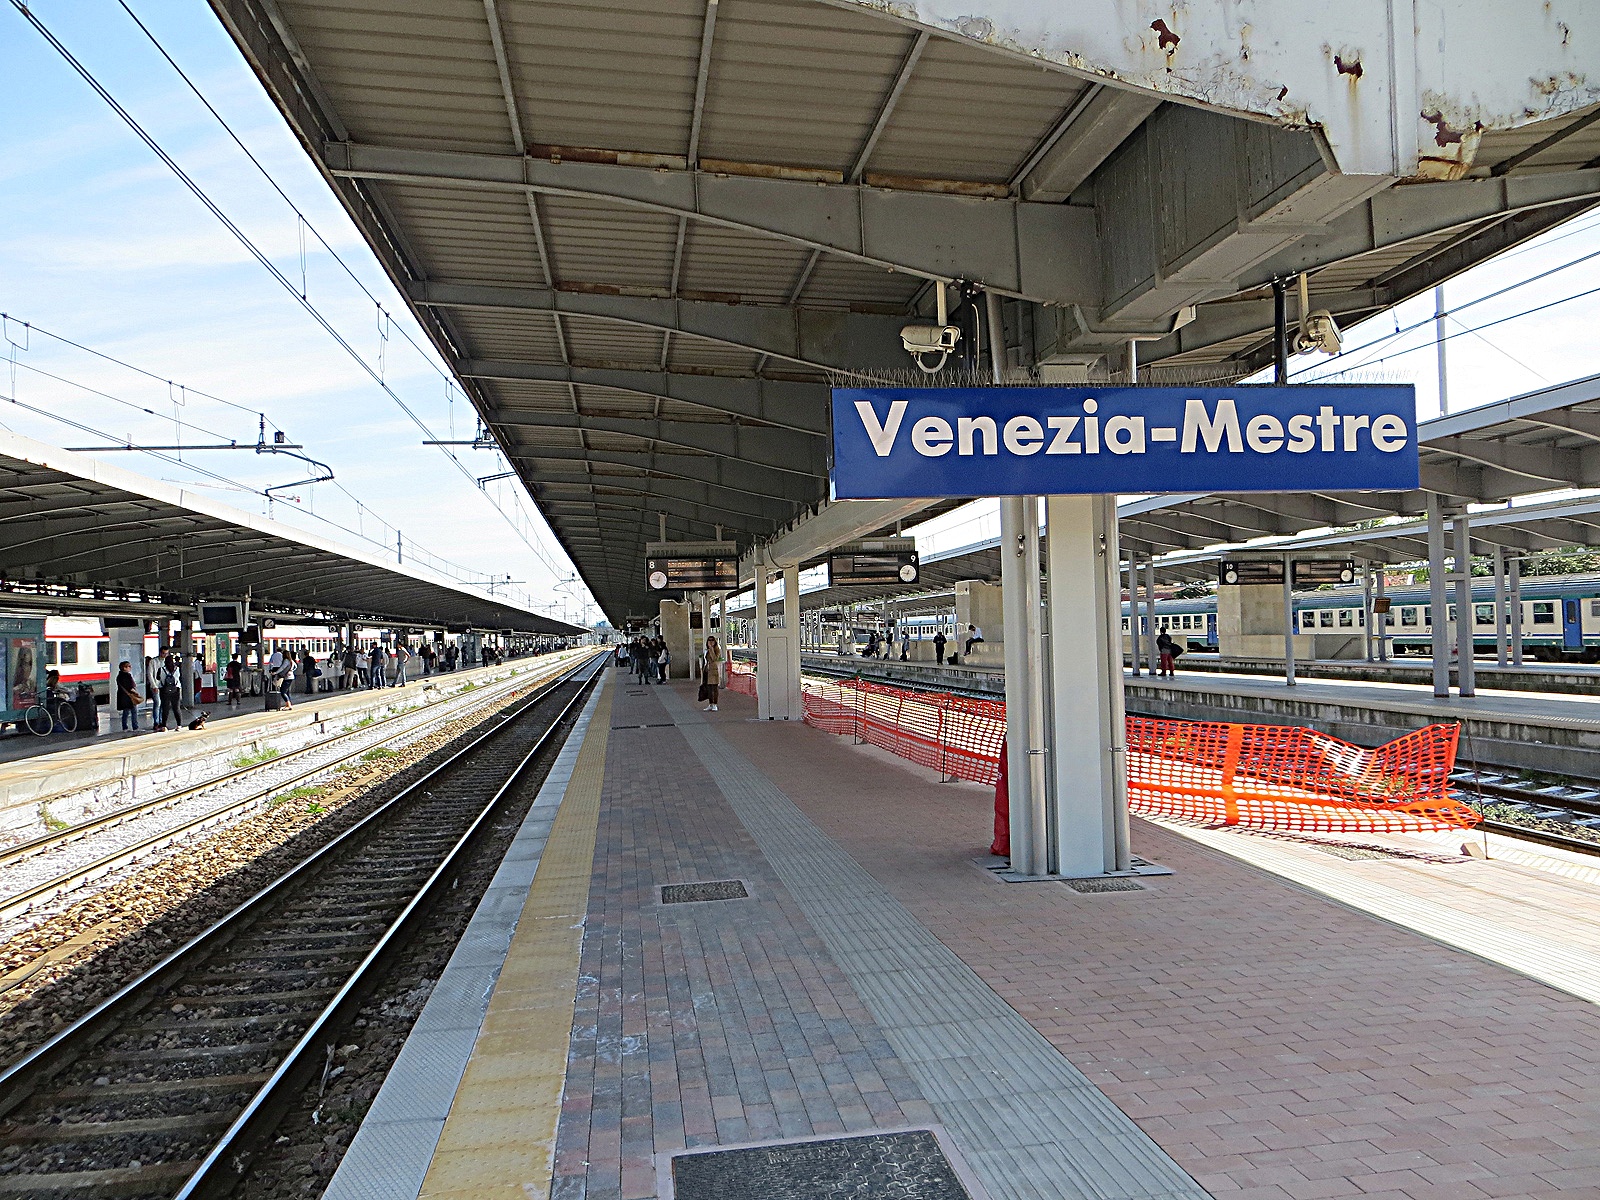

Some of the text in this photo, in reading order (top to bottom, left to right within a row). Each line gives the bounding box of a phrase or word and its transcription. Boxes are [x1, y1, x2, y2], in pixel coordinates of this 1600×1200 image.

[853, 398, 1409, 458] Venezia-Mestre
[910, 555, 917, 563] 9
[648, 561, 655, 569] 8
